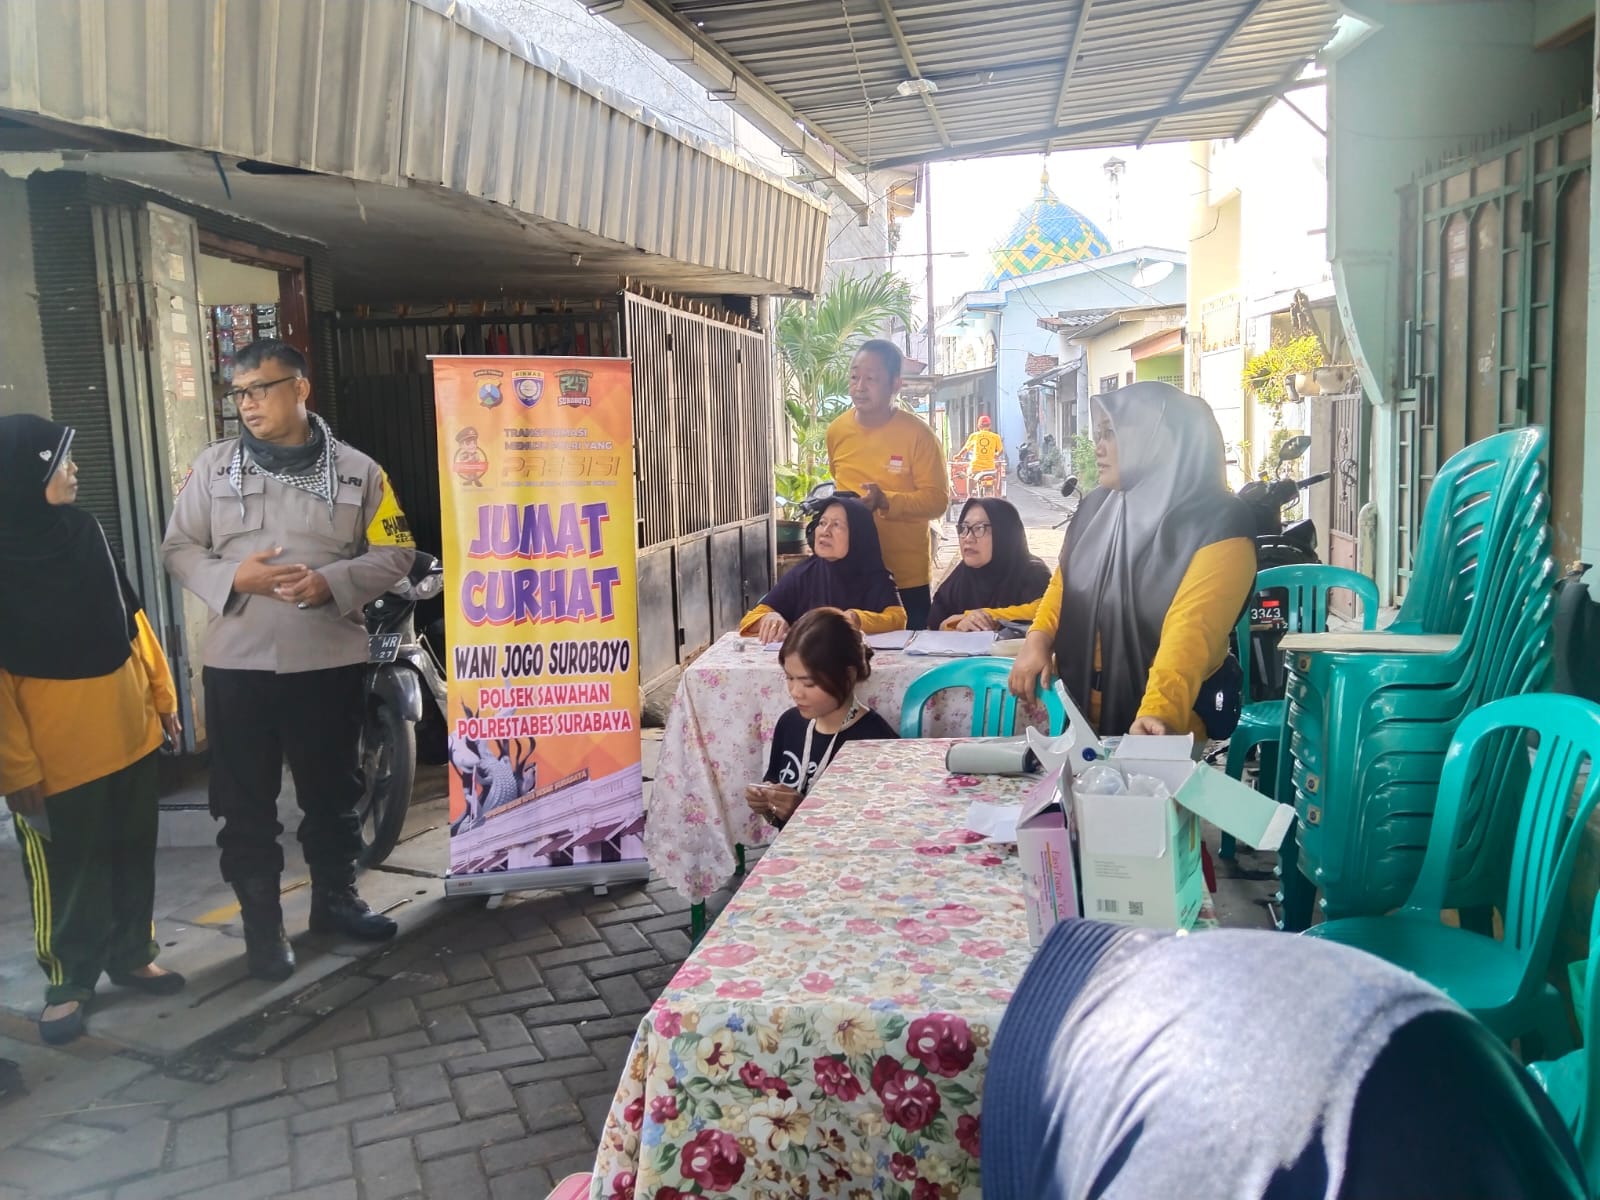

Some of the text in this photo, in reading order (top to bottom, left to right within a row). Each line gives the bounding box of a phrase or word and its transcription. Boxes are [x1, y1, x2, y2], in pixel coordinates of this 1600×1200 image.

[585, 441, 613, 450] YANG
[468, 502, 610, 560] JUMAT
[461, 566, 621, 627] CURHAT
[381, 636, 398, 648] WR
[455, 639, 630, 680] WANI JOGO SUROBOYO
[479, 683, 611, 710] POLSEK SAWAHAN
[457, 709, 632, 741] POLRESTABES SURABAYA
